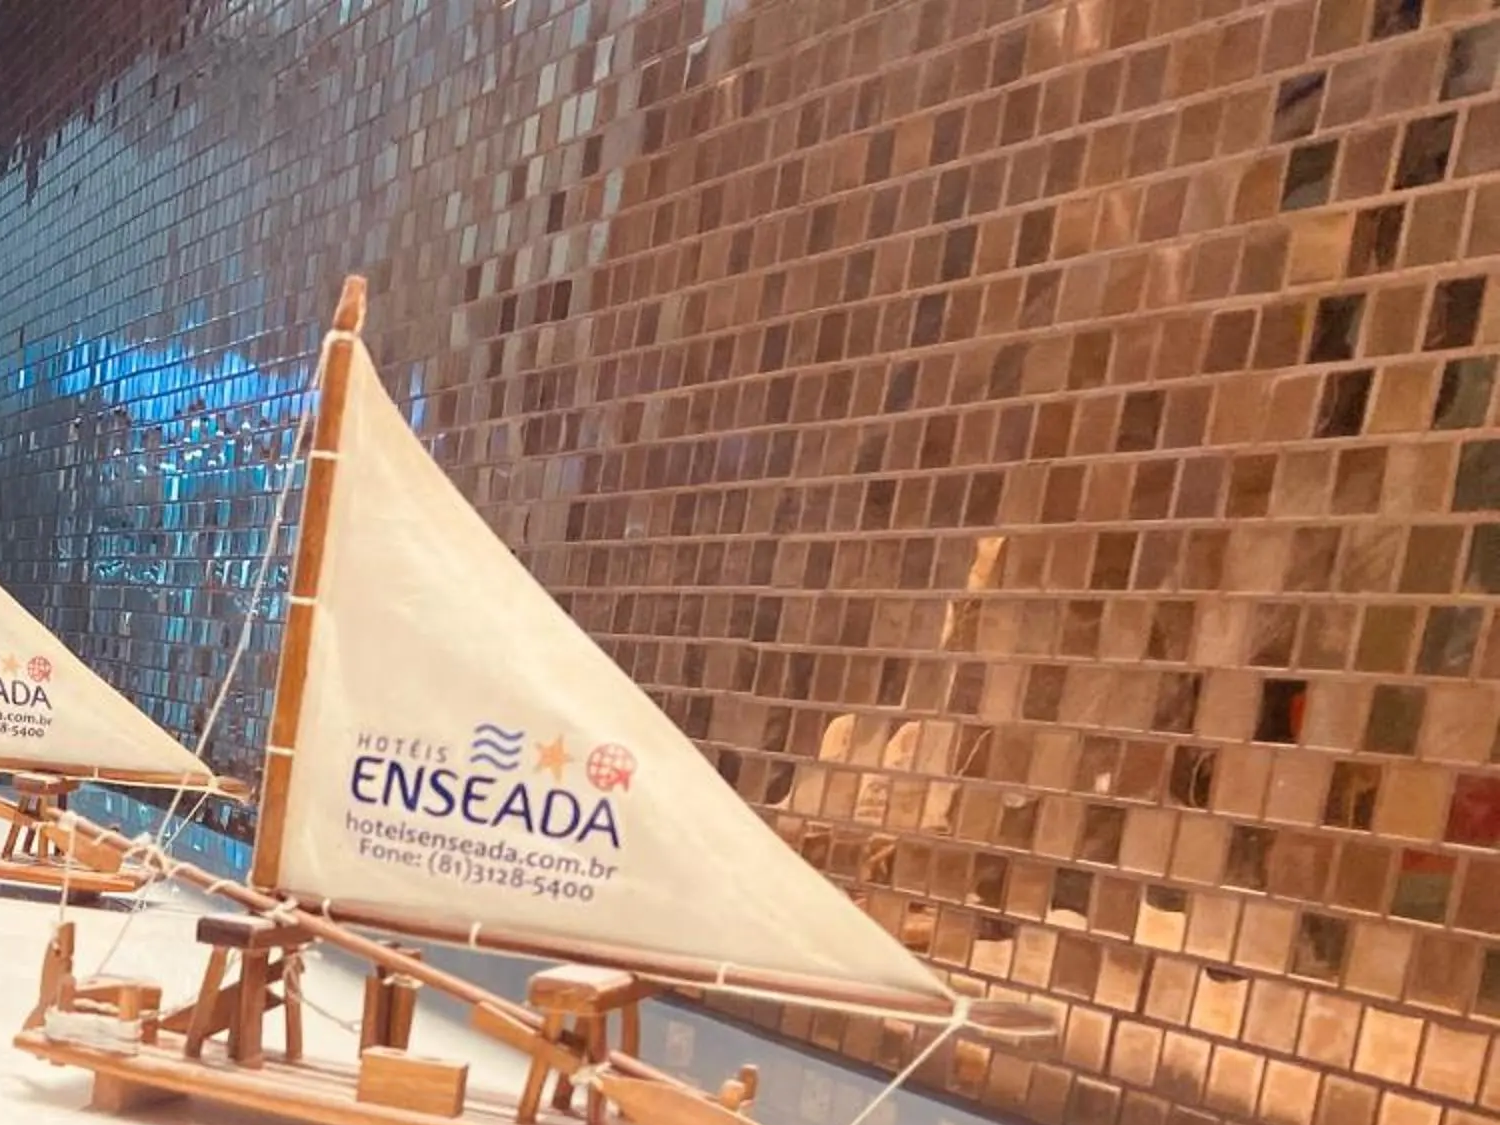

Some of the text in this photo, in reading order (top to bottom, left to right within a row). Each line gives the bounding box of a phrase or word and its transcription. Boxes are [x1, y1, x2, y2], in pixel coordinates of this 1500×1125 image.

[357, 731, 450, 765] HOTÉIS
[350, 754, 622, 850] ENSEADA
[345, 809, 620, 881] hoteisenseada.com.br
[358, 837, 595, 902] Fone: (81)3128-5400
